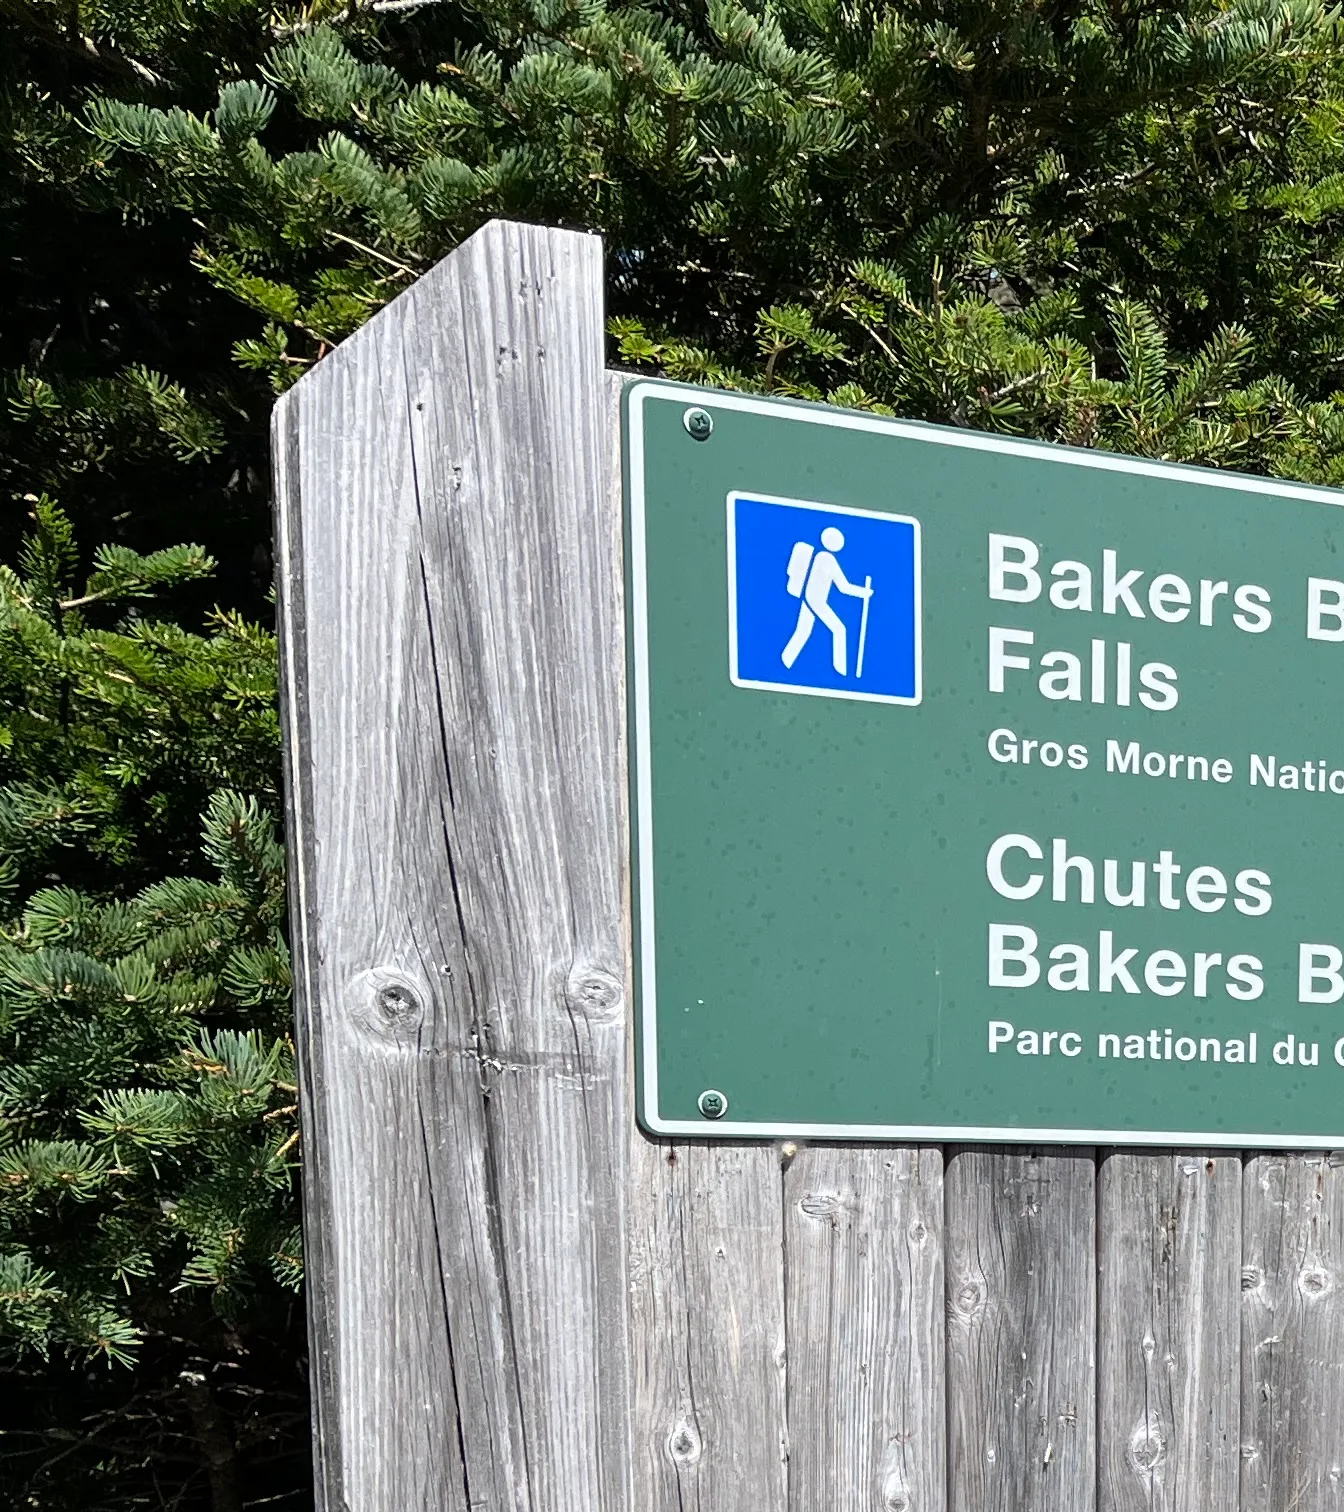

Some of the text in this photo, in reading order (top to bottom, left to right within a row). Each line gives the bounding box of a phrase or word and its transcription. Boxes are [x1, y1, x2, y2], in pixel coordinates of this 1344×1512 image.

[988, 532, 1273, 634] Bakers
[988, 626, 1179, 712] Falls
[987, 727, 1089, 770] Gros
[1106, 739, 1234, 784] Morne
[986, 833, 1273, 916] Chutes
[988, 922, 1265, 1001] Bakers
[988, 1020, 1082, 1057] Parc
[1098, 1032, 1257, 1064] national
[1272, 1033, 1319, 1066] du
